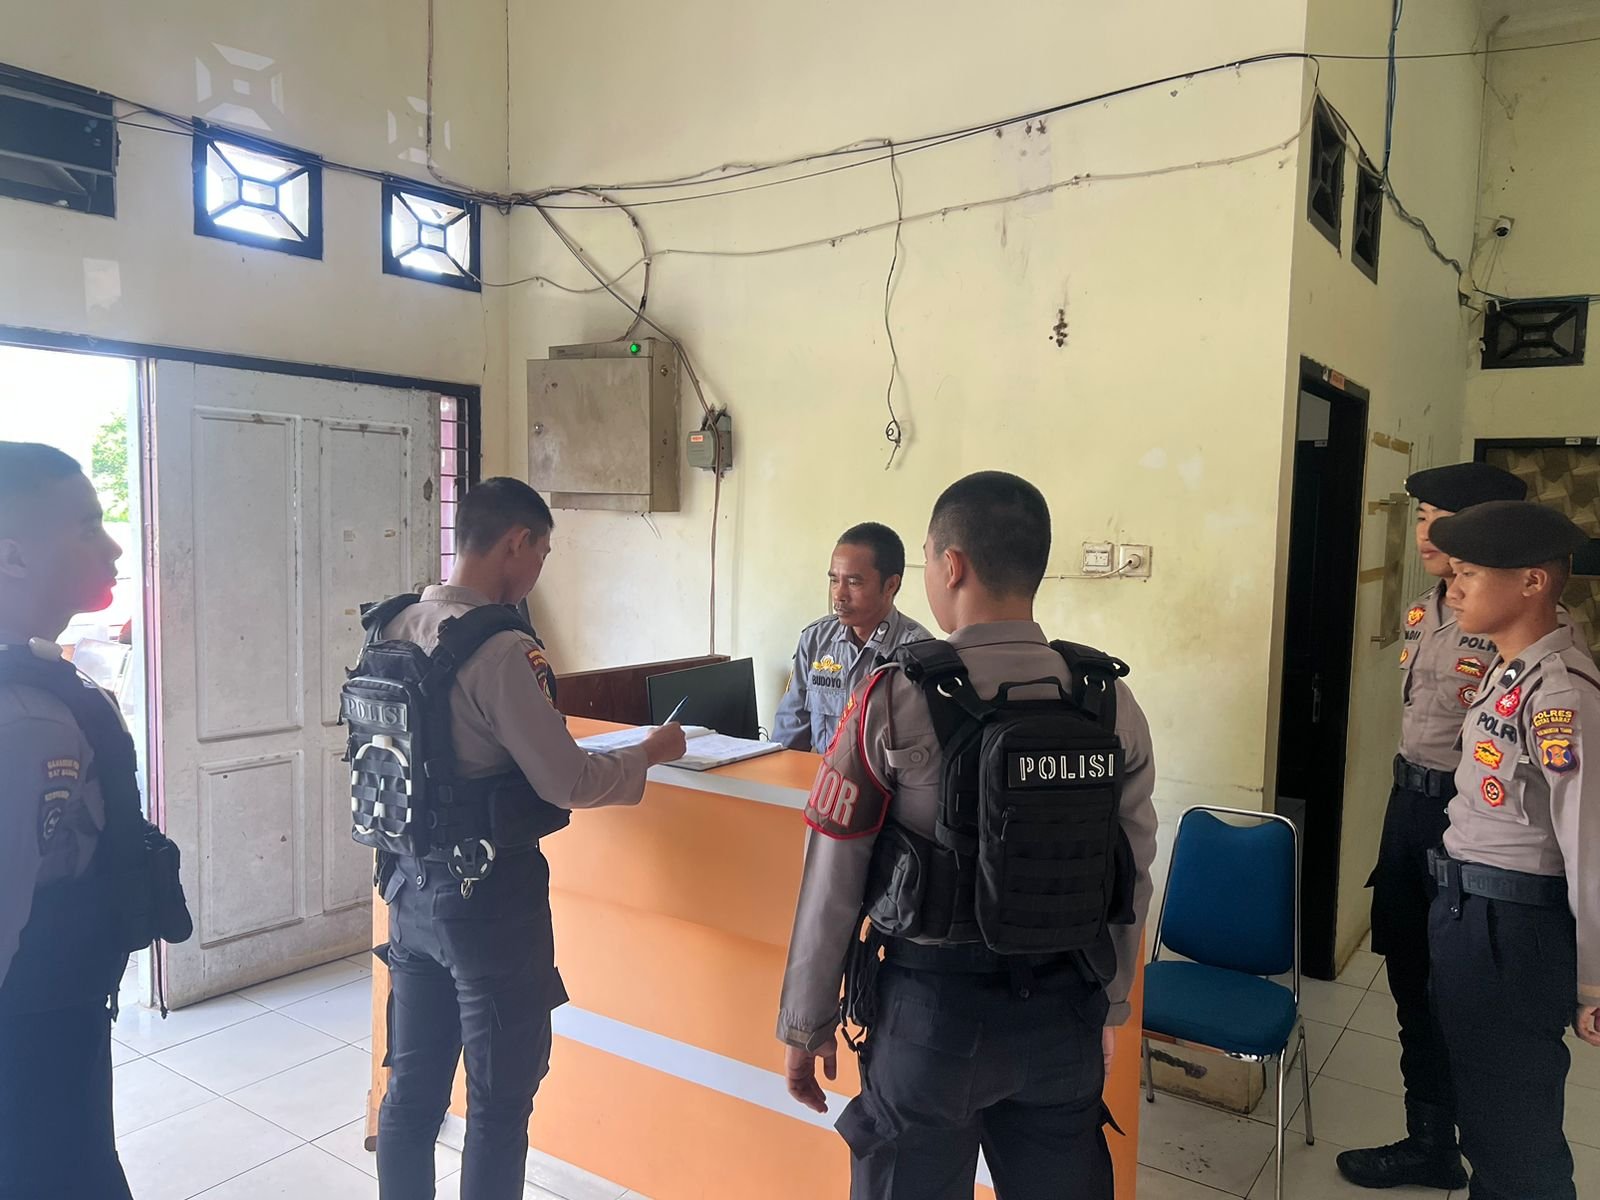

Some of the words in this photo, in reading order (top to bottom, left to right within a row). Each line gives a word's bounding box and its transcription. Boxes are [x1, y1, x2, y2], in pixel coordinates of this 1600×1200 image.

[1458, 635, 1498, 653] POLR
[812, 674, 842, 689] BUDOYO
[346, 697, 405, 726] POLISI
[1476, 711, 1518, 744] POLRI
[1019, 753, 1114, 781] POLISI
[809, 763, 858, 827] OR
